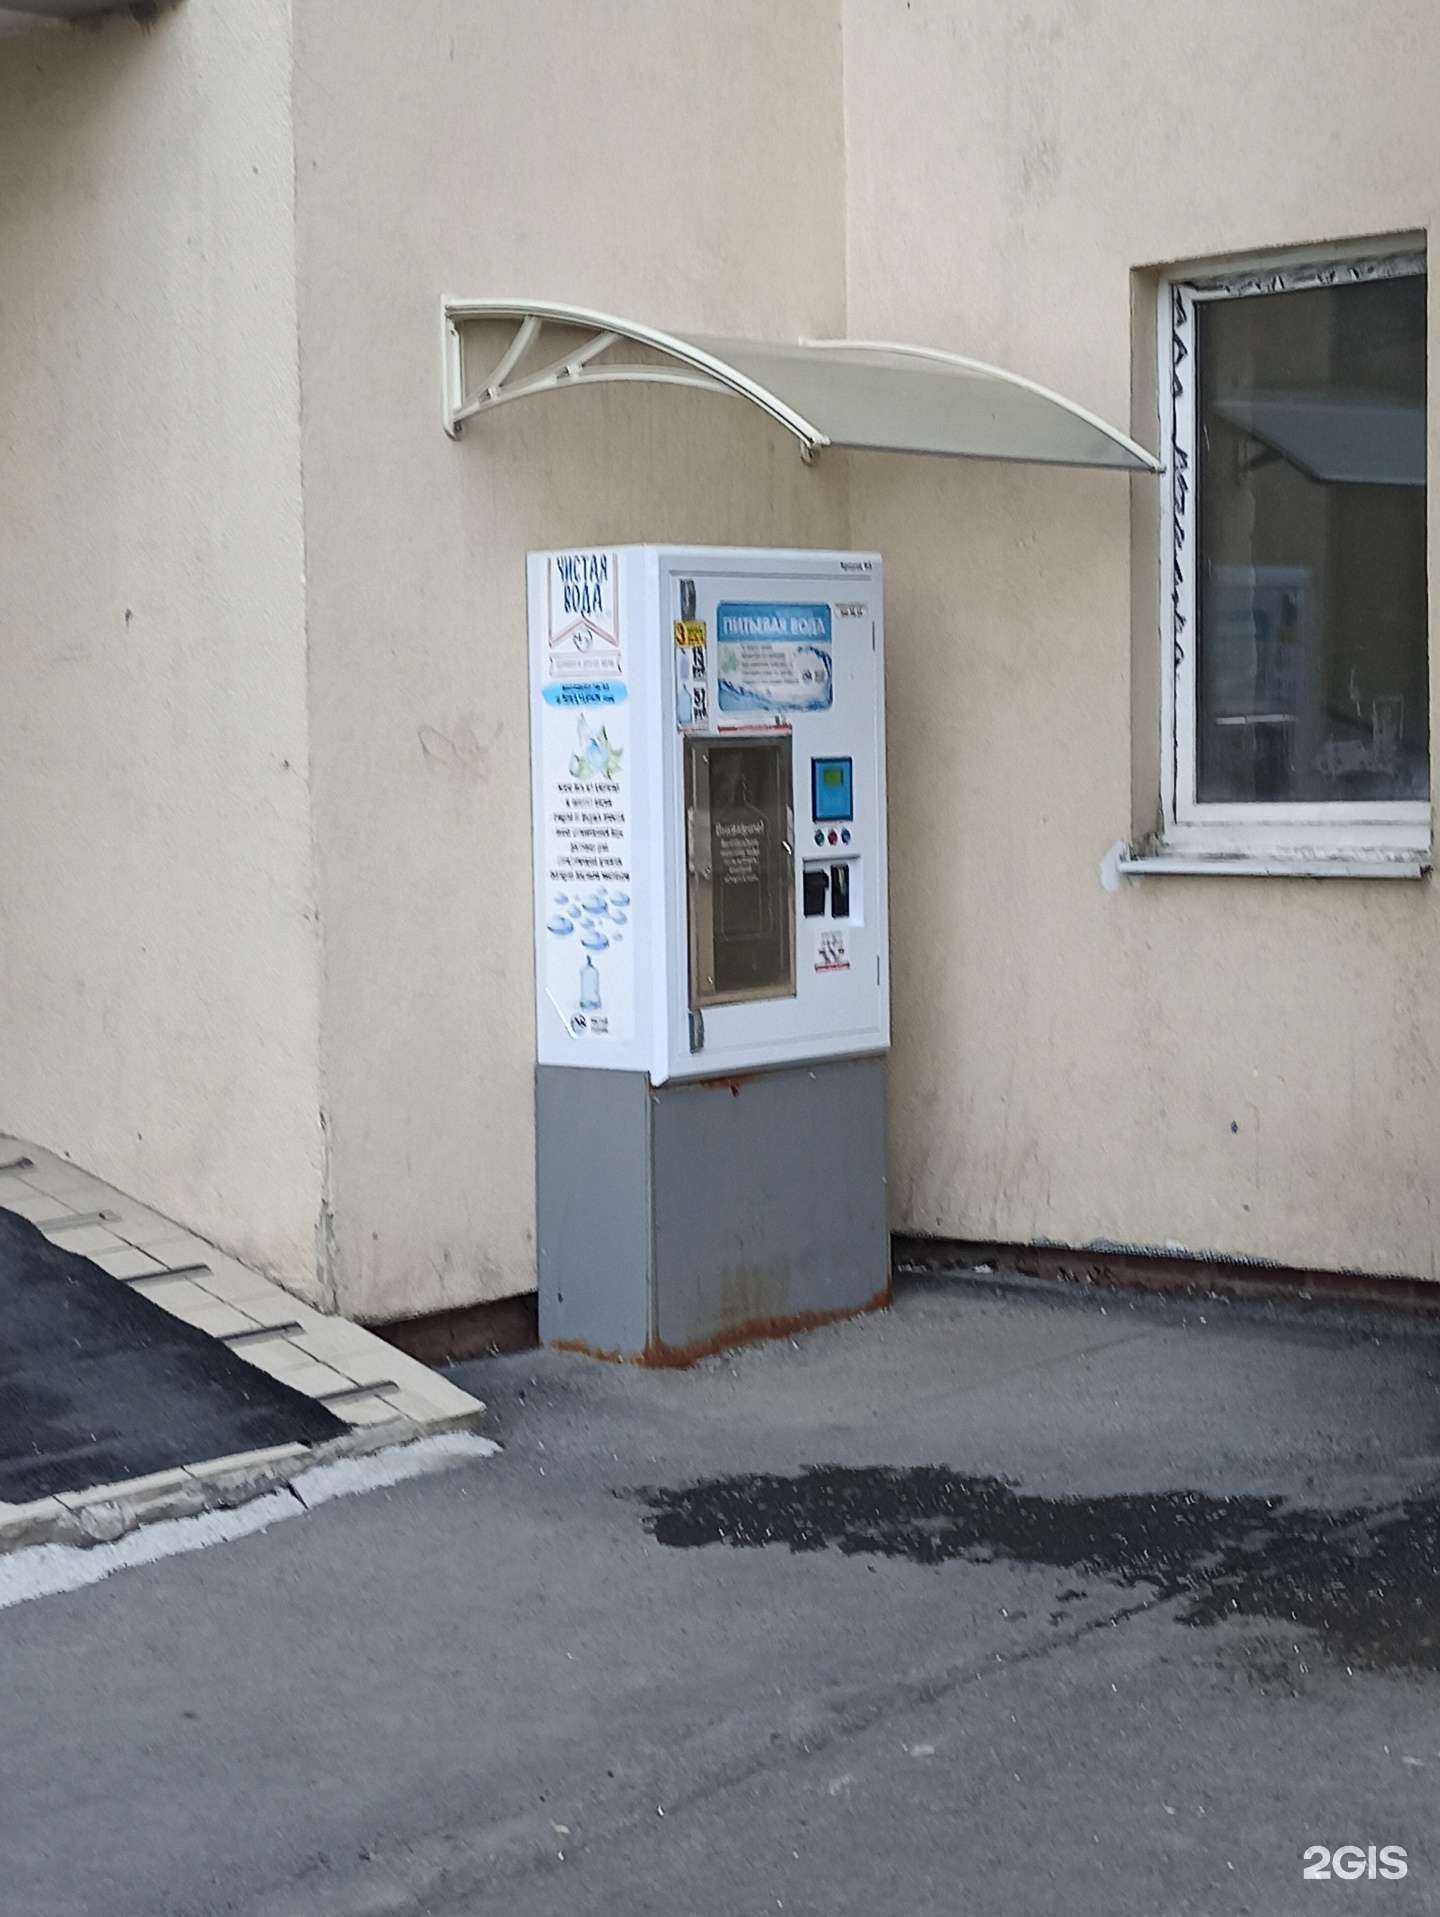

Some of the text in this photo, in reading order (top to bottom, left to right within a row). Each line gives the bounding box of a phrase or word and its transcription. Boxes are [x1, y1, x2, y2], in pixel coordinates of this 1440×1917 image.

[557, 553, 608, 582] ЧИСТАЯ
[563, 581, 603, 614] ВОДА
[790, 615, 826, 637] ВОДА
